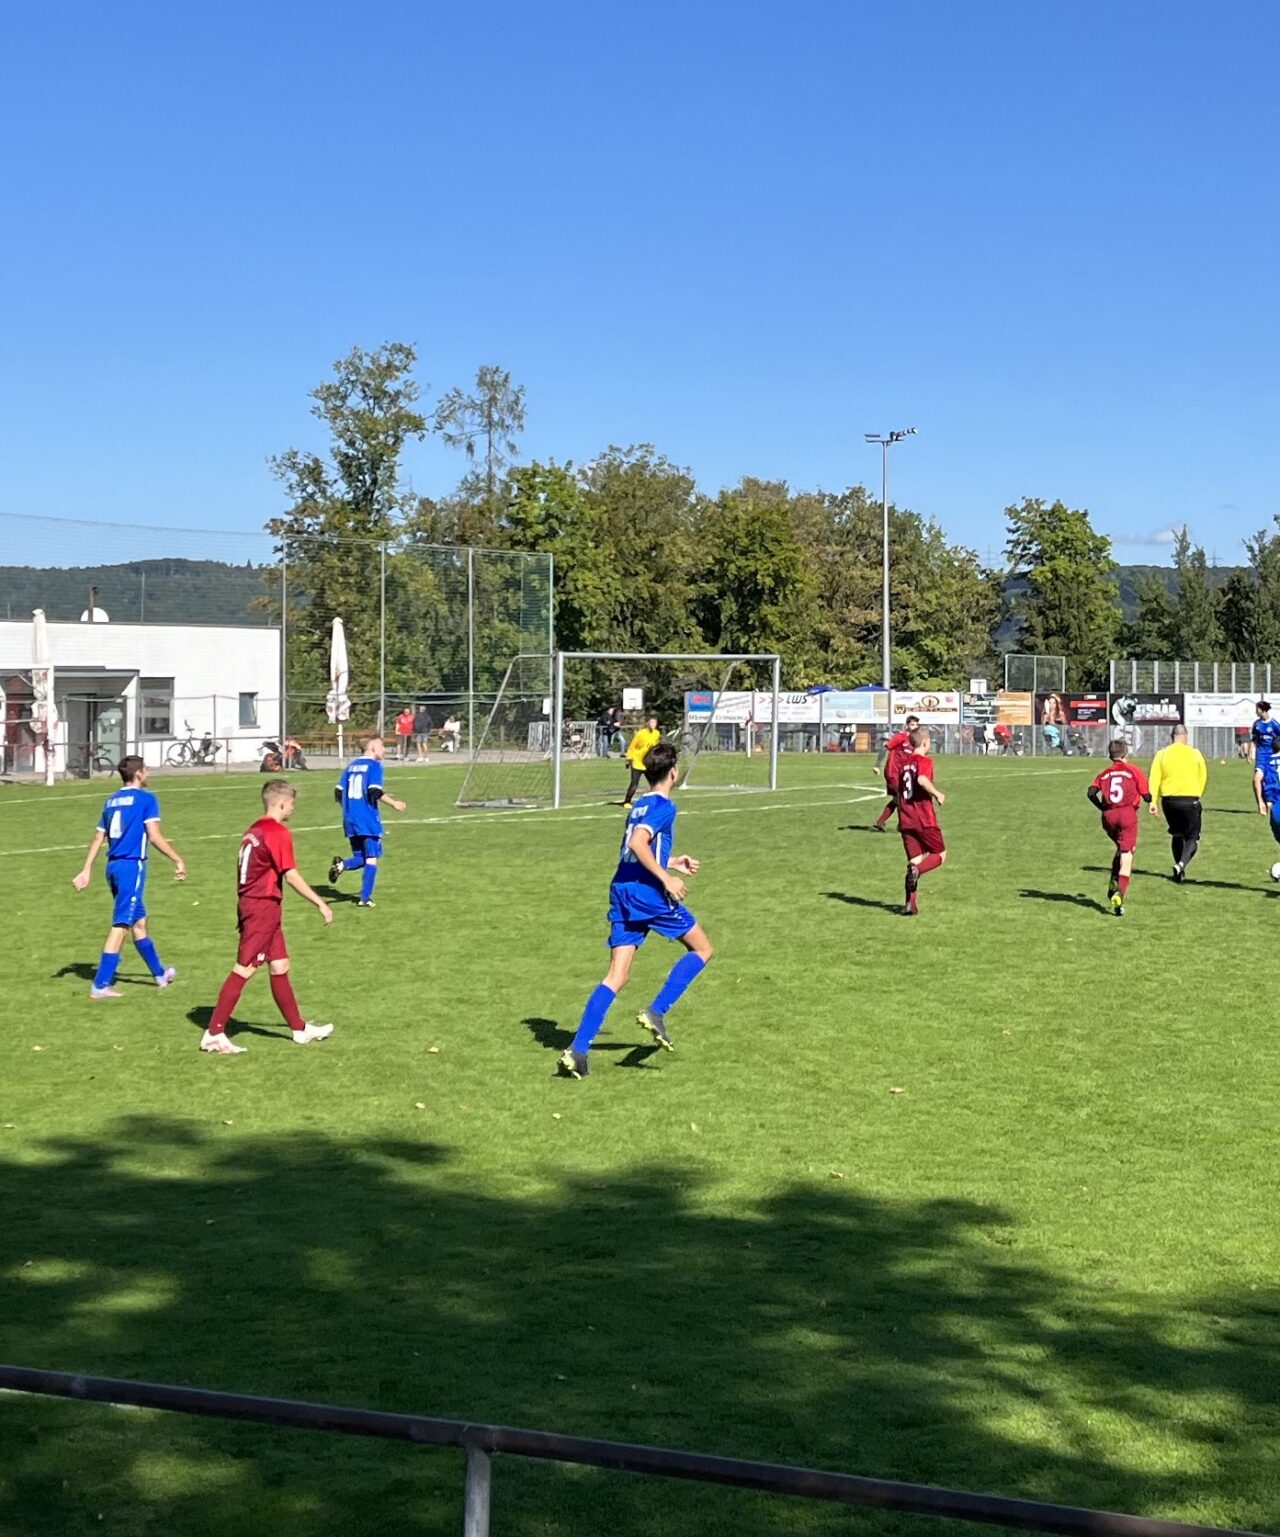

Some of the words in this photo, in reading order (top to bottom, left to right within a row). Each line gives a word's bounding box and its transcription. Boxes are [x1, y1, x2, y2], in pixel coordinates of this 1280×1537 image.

[348, 774, 363, 799] 10
[1109, 776, 1124, 804] 5
[109, 810, 123, 839] 4
